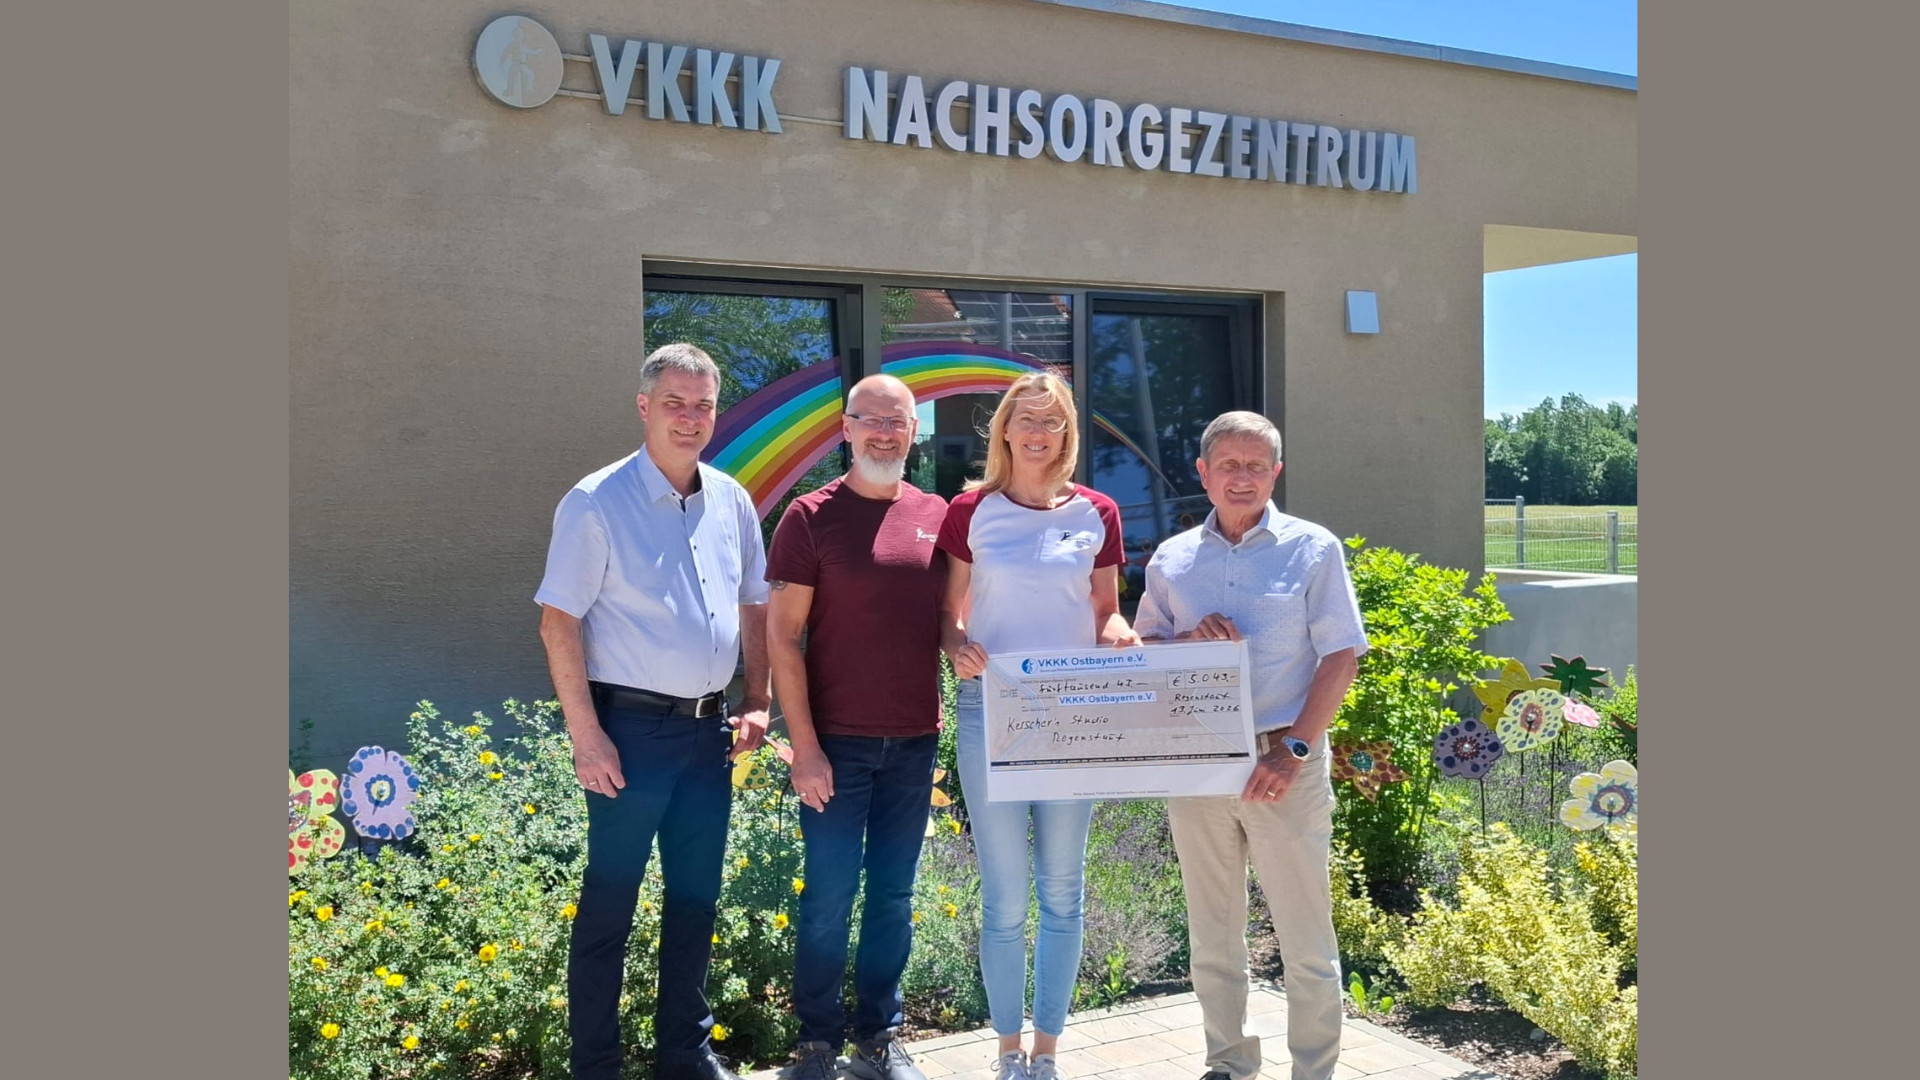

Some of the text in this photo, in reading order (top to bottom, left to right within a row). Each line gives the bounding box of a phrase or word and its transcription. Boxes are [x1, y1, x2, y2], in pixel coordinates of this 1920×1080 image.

[589, 33, 1418, 195] VKKK NACHSORGEZENTRUM
[1038, 653, 1146, 667] VKKK Ostbayern e.V.
[1059, 695, 1085, 704] VKKK
[1088, 693, 1136, 703] Ostbayern
[1137, 692, 1155, 701] e.V.
[1213, 704, 1240, 712] 2026
[1070, 715, 1109, 725] Studio
